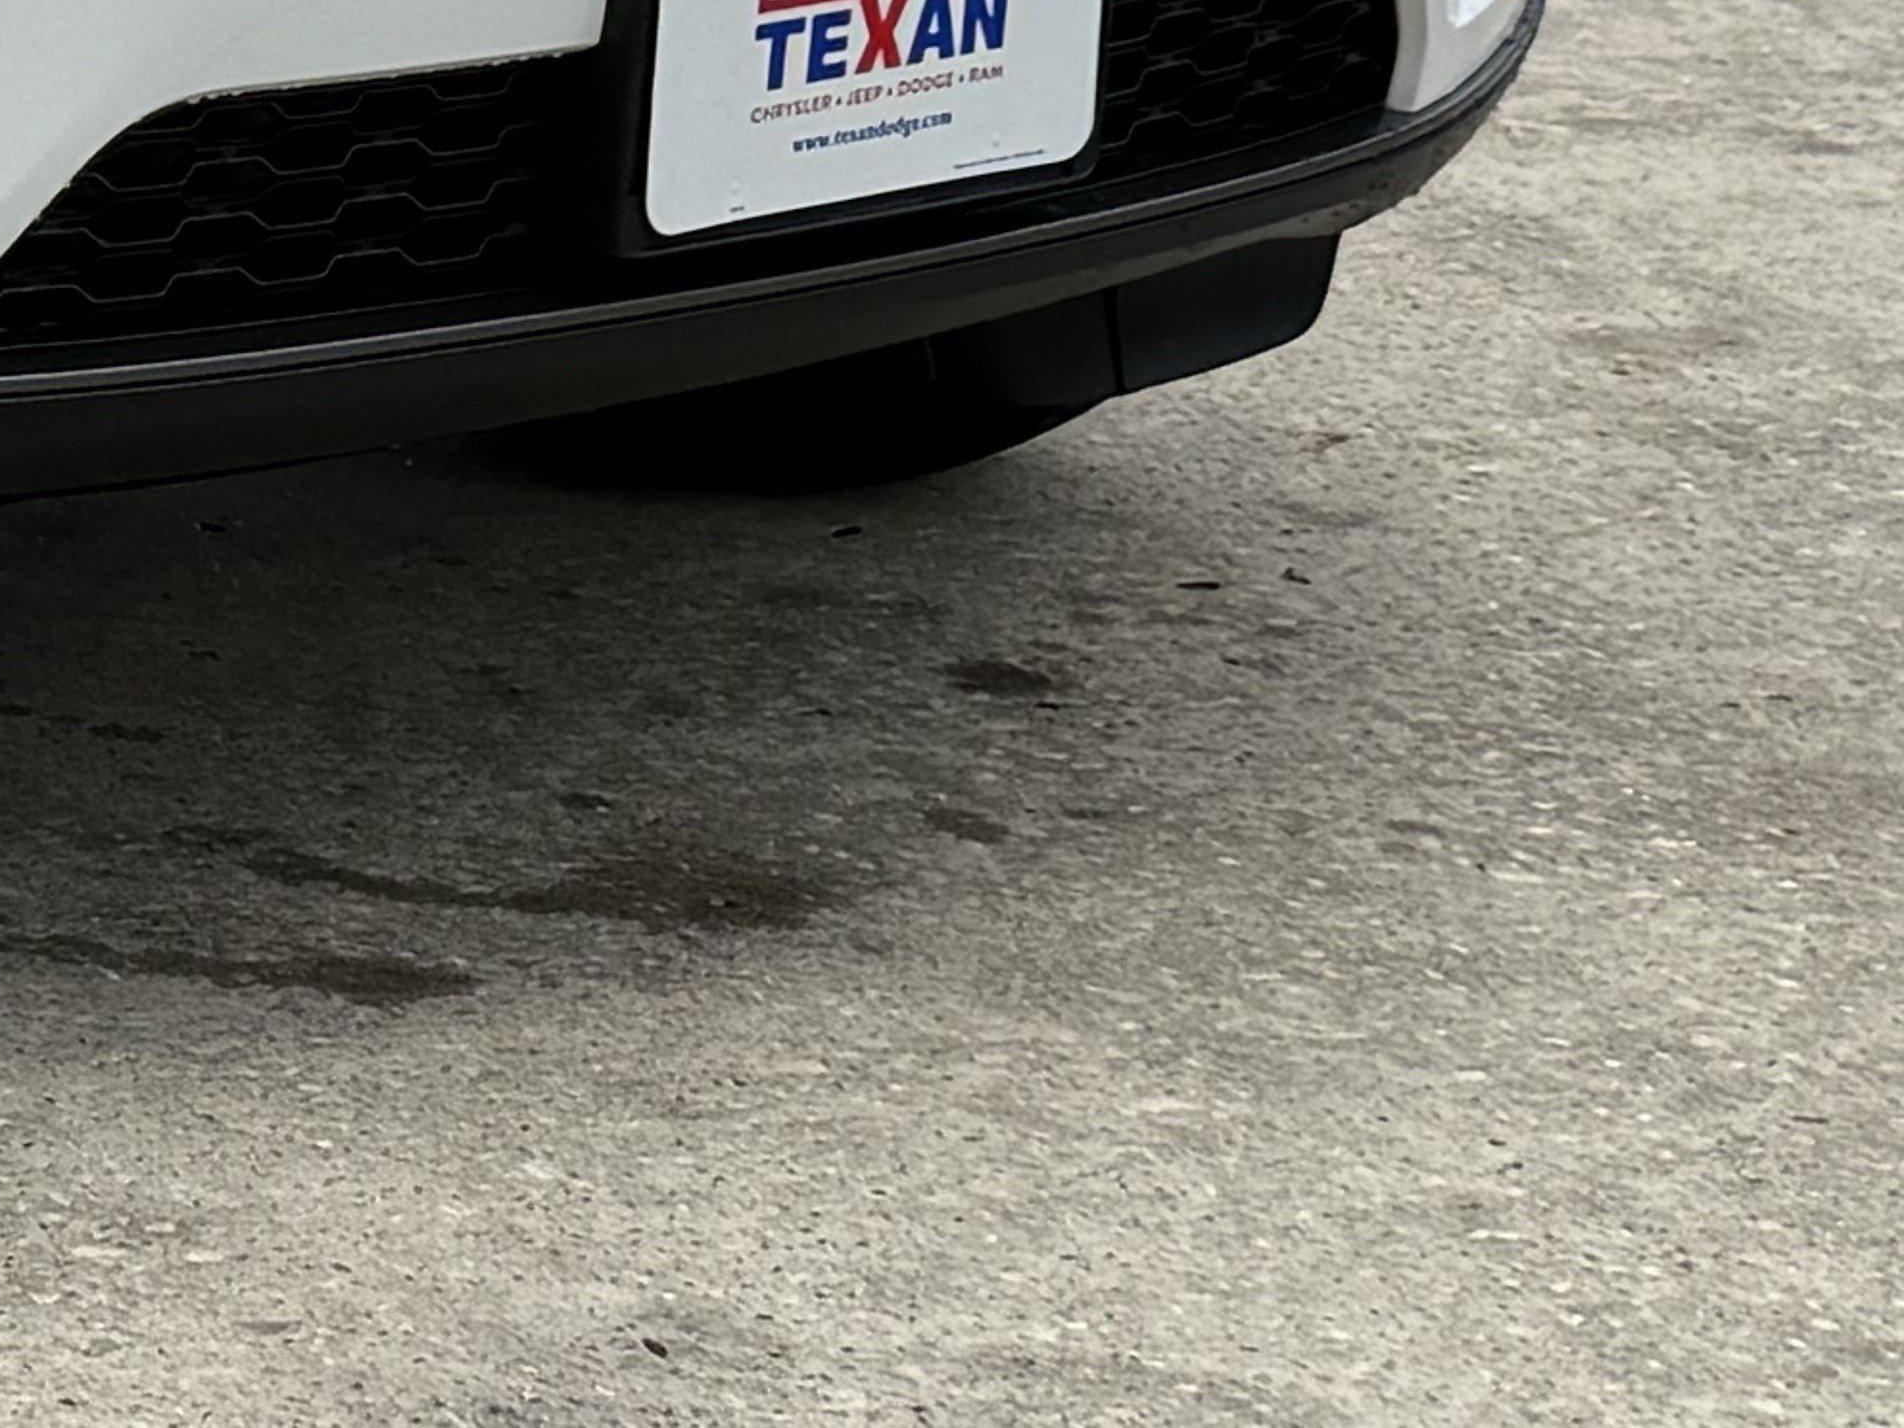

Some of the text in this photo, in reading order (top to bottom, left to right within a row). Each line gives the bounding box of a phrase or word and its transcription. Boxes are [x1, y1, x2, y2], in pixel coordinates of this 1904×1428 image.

[750, 64, 1004, 124] CHRYSLER JEEP DODGE RAM
[792, 111, 953, 153] www.texandodge.com
